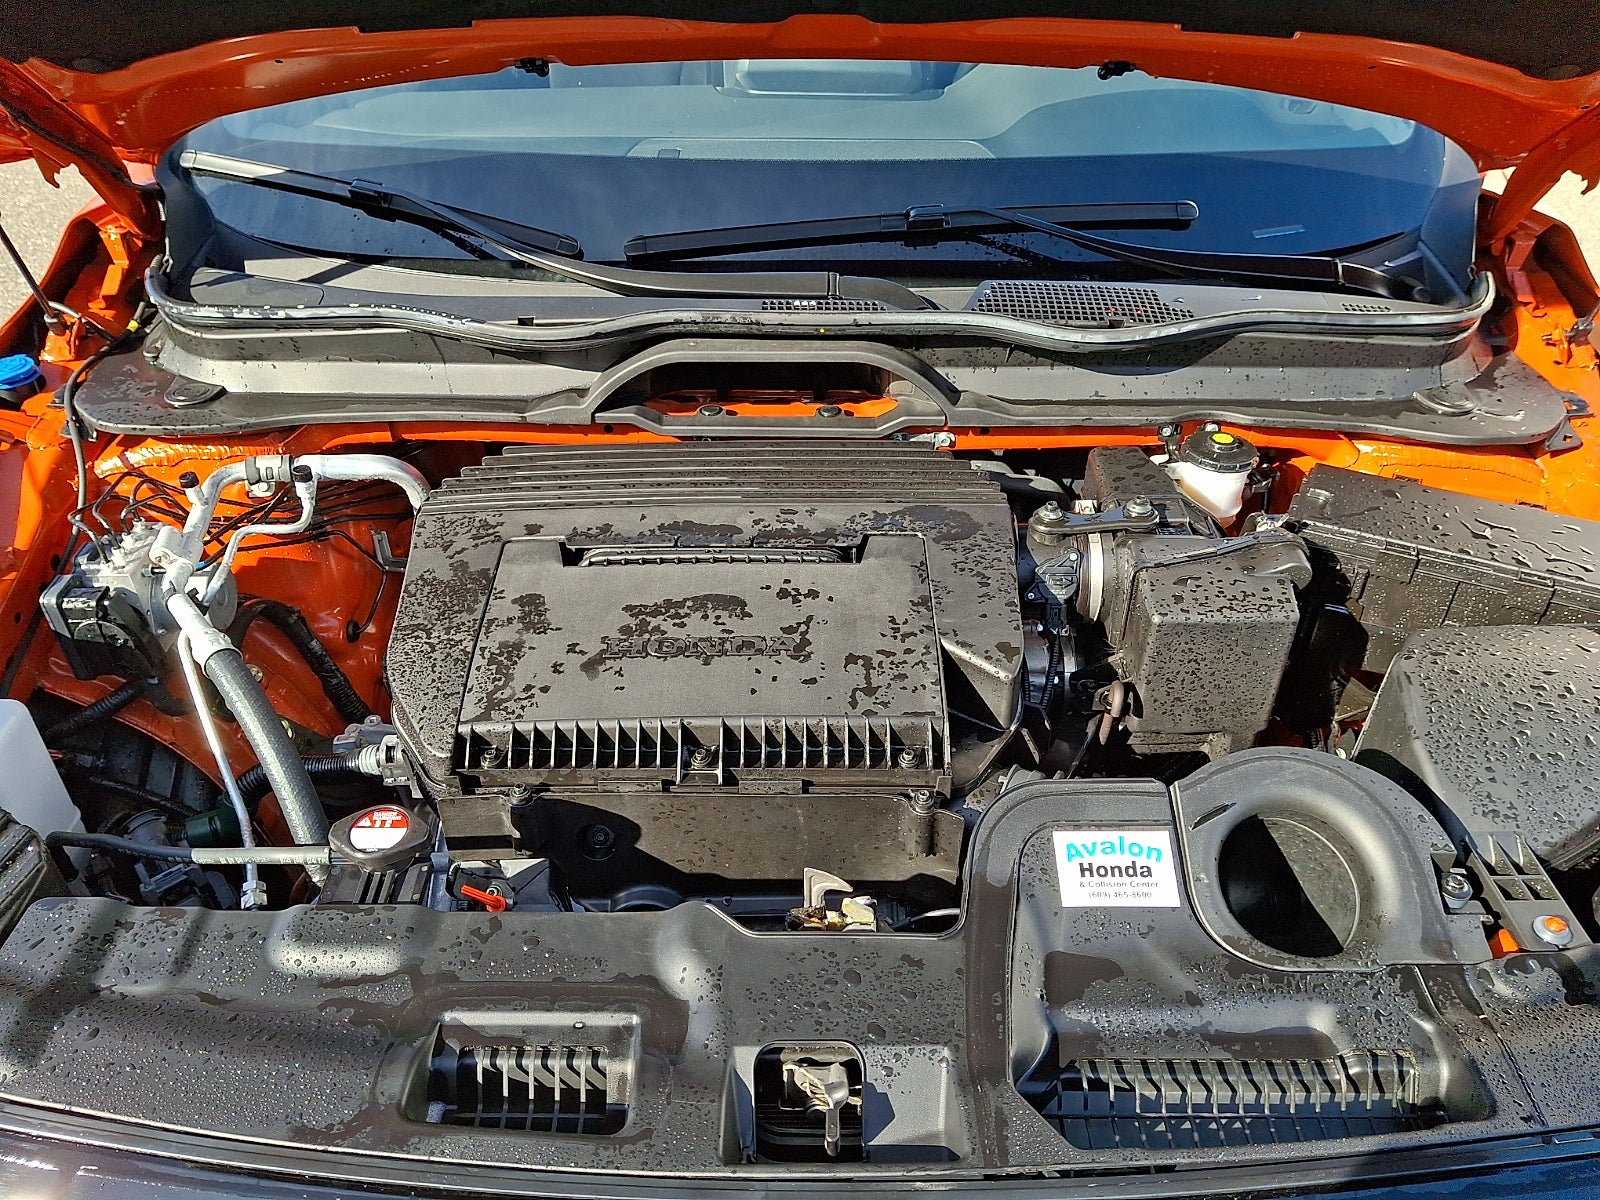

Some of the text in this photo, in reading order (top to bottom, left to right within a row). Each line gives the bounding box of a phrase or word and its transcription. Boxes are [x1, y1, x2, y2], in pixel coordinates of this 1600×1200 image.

[602, 636, 812, 658] HONDA
[1066, 835, 1163, 863] Avalon
[1079, 860, 1153, 878] Honda
[1088, 880, 1127, 888] Collision
[1129, 880, 1159, 888] Center
